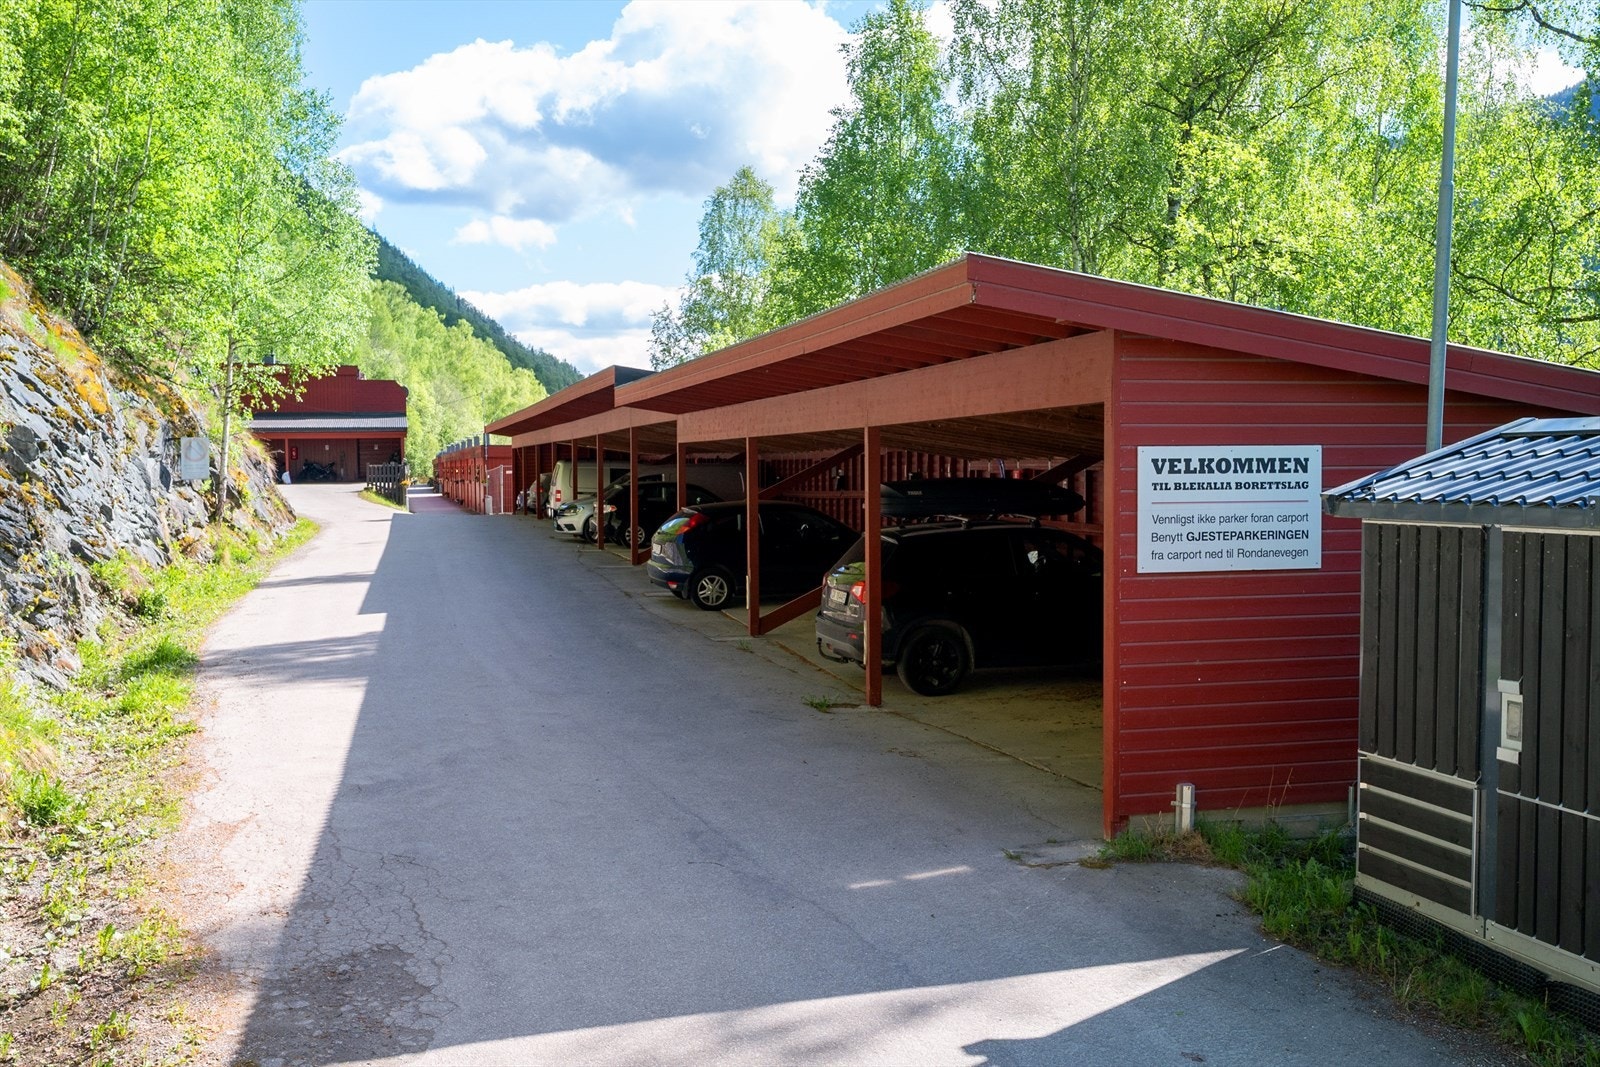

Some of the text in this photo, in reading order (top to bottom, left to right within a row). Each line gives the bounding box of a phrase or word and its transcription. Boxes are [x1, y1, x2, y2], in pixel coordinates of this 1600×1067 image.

[1151, 458, 1309, 474] VELKOMMEN
[1152, 481, 1309, 491] TIL BLEKALIA BORETTSLAG
[1152, 513, 1309, 526] Vennligst ikke parker foran carport
[1151, 530, 1309, 544] Benytt GJESTEPARKERINGEN
[1151, 548, 1309, 561] fra carport ned til Rondanevegen
